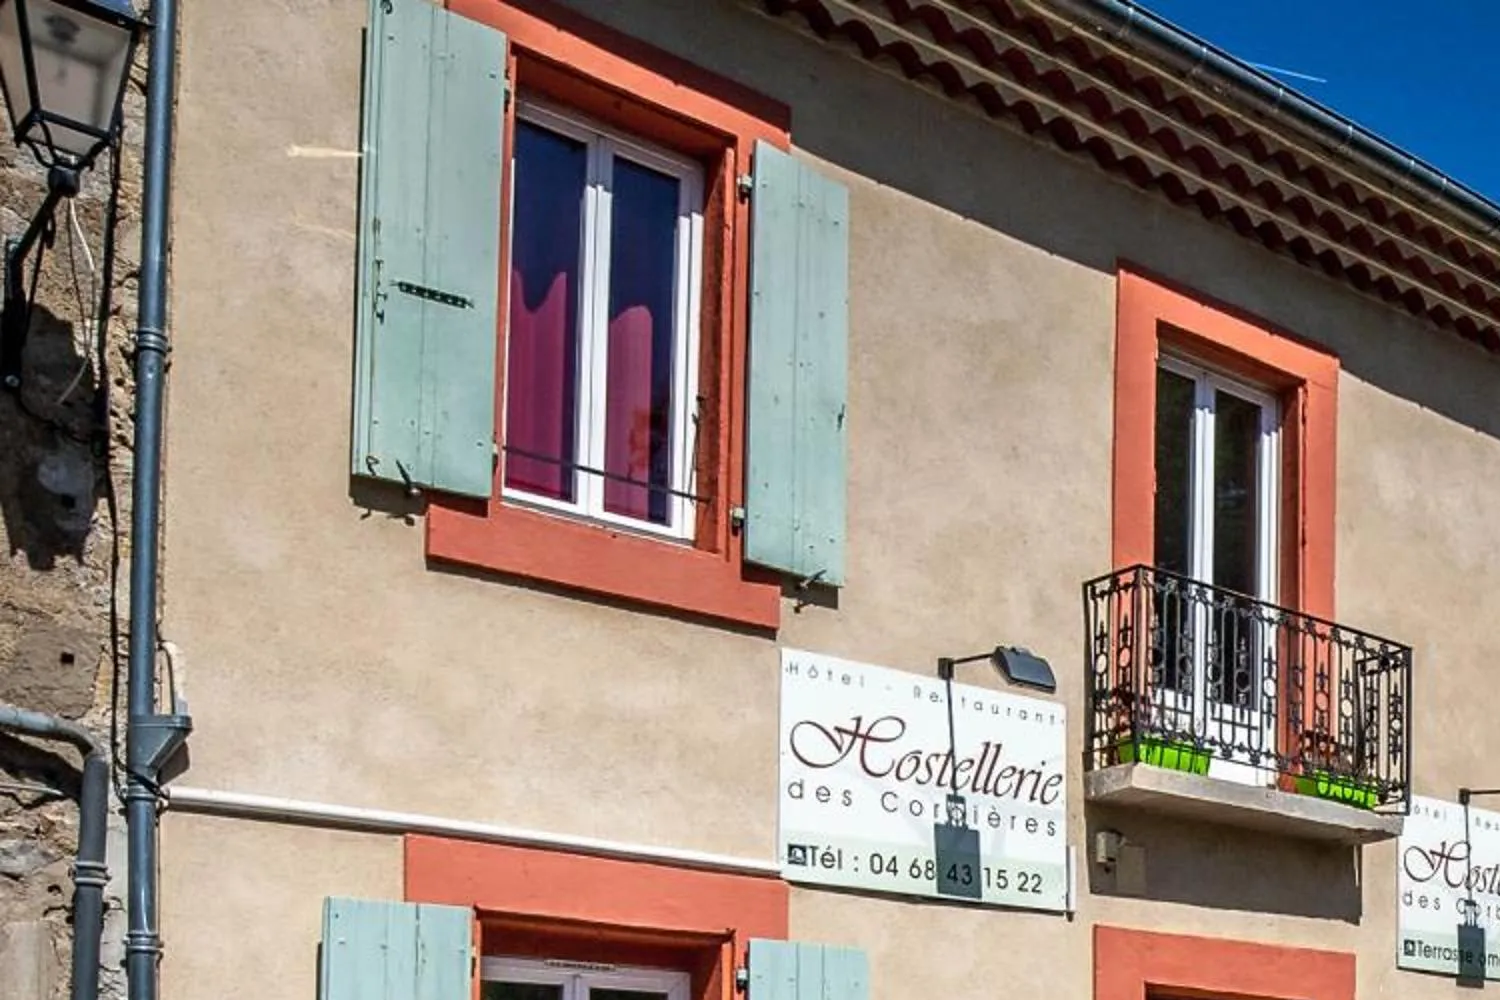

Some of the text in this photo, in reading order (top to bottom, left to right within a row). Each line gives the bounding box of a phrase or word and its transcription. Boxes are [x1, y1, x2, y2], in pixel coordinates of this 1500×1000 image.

[789, 661, 865, 688] Hôtel
[913, 684, 1056, 725] Retaurant
[790, 715, 1064, 806] Hostellerie
[787, 779, 853, 807] des
[808, 844, 844, 870] Tél
[869, 853, 900, 877] 04
[909, 858, 935, 881] 68
[946, 863, 973, 885] 43
[984, 867, 1009, 890] 15
[1017, 871, 1043, 895] 22
[1402, 890, 1441, 911] des
